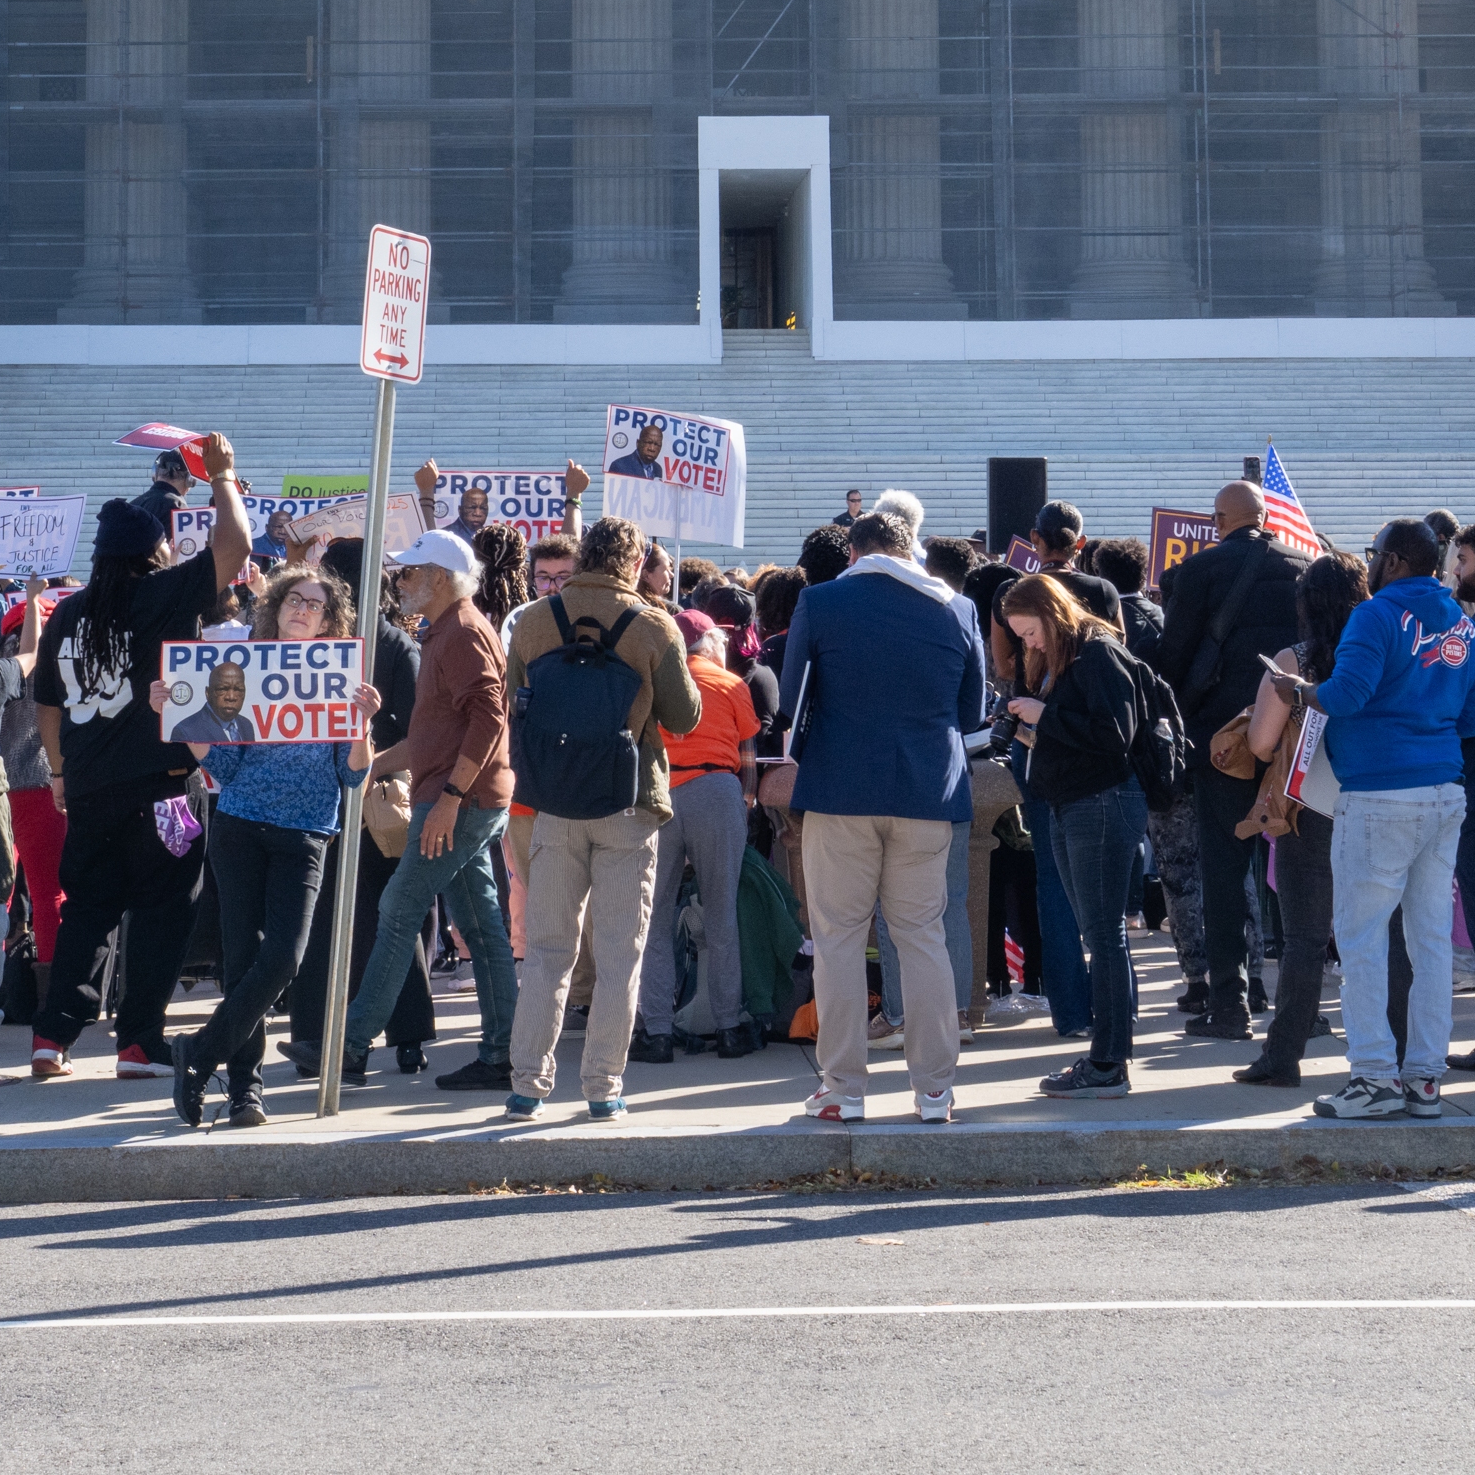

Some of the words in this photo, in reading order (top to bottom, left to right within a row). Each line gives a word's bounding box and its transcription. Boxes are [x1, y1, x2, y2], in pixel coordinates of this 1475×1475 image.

[388, 242, 410, 270] NO
[372, 268, 422, 303] PARKING
[382, 302, 408, 325] ANY
[379, 323, 408, 348] TIME
[614, 408, 726, 448] PROTECT
[672, 439, 719, 467] OUR
[434, 475, 567, 497] PROTECT
[663, 456, 723, 493] VOTE!
[289, 486, 313, 498] DO
[332, 512, 367, 524] Voic
[500, 498, 566, 518] OUR
[0, 513, 65, 540] FREEDOM
[6, 546, 59, 564] JUSTICE
[16, 564, 34, 574] FOR
[41, 564, 55, 574] ALL
[169, 642, 357, 672] PROTECT
[261, 672, 347, 700] OUR
[251, 703, 359, 739] VOTE!
